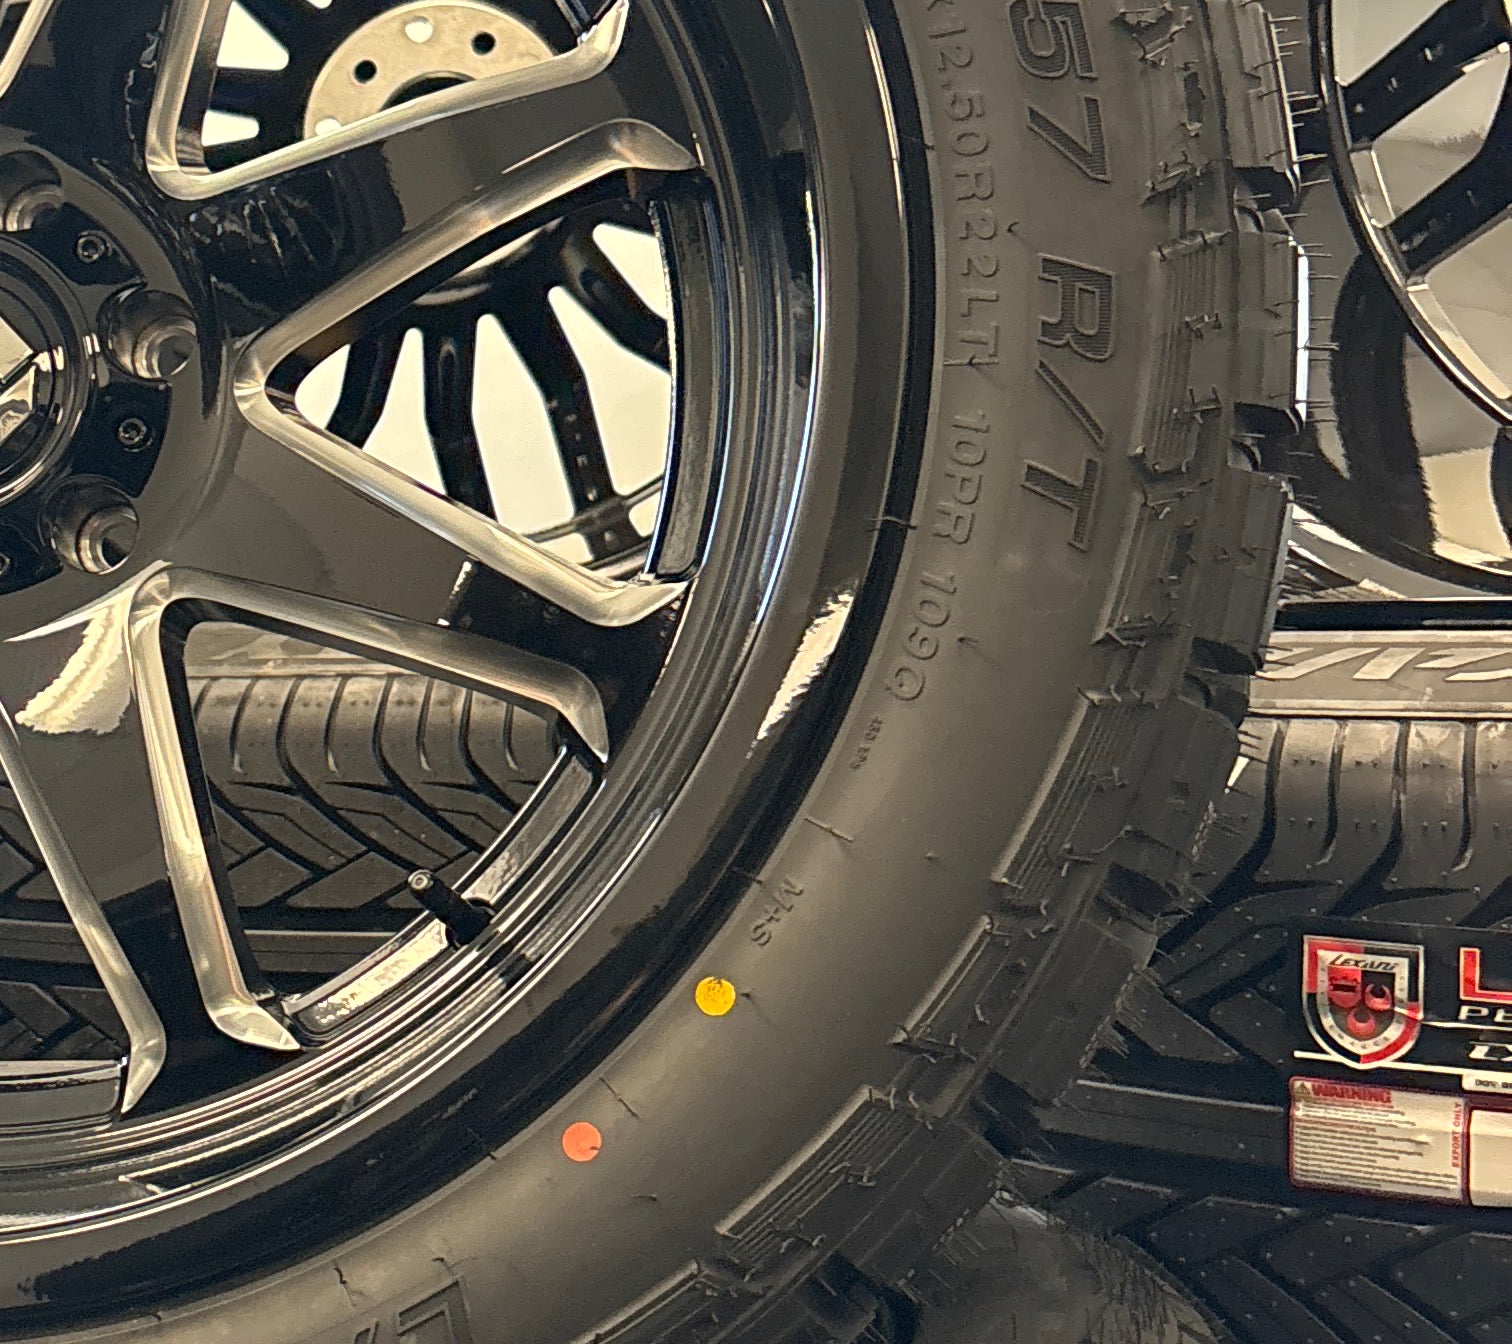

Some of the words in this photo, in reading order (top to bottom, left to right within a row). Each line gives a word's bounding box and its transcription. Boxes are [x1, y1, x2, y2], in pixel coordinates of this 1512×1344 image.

[1018, 254, 1117, 552] R/T
[930, 411, 990, 546] 10PR
[885, 570, 958, 703] 109Q
[749, 878, 805, 948] M+S
[1452, 1101, 1463, 1128] ONLY
